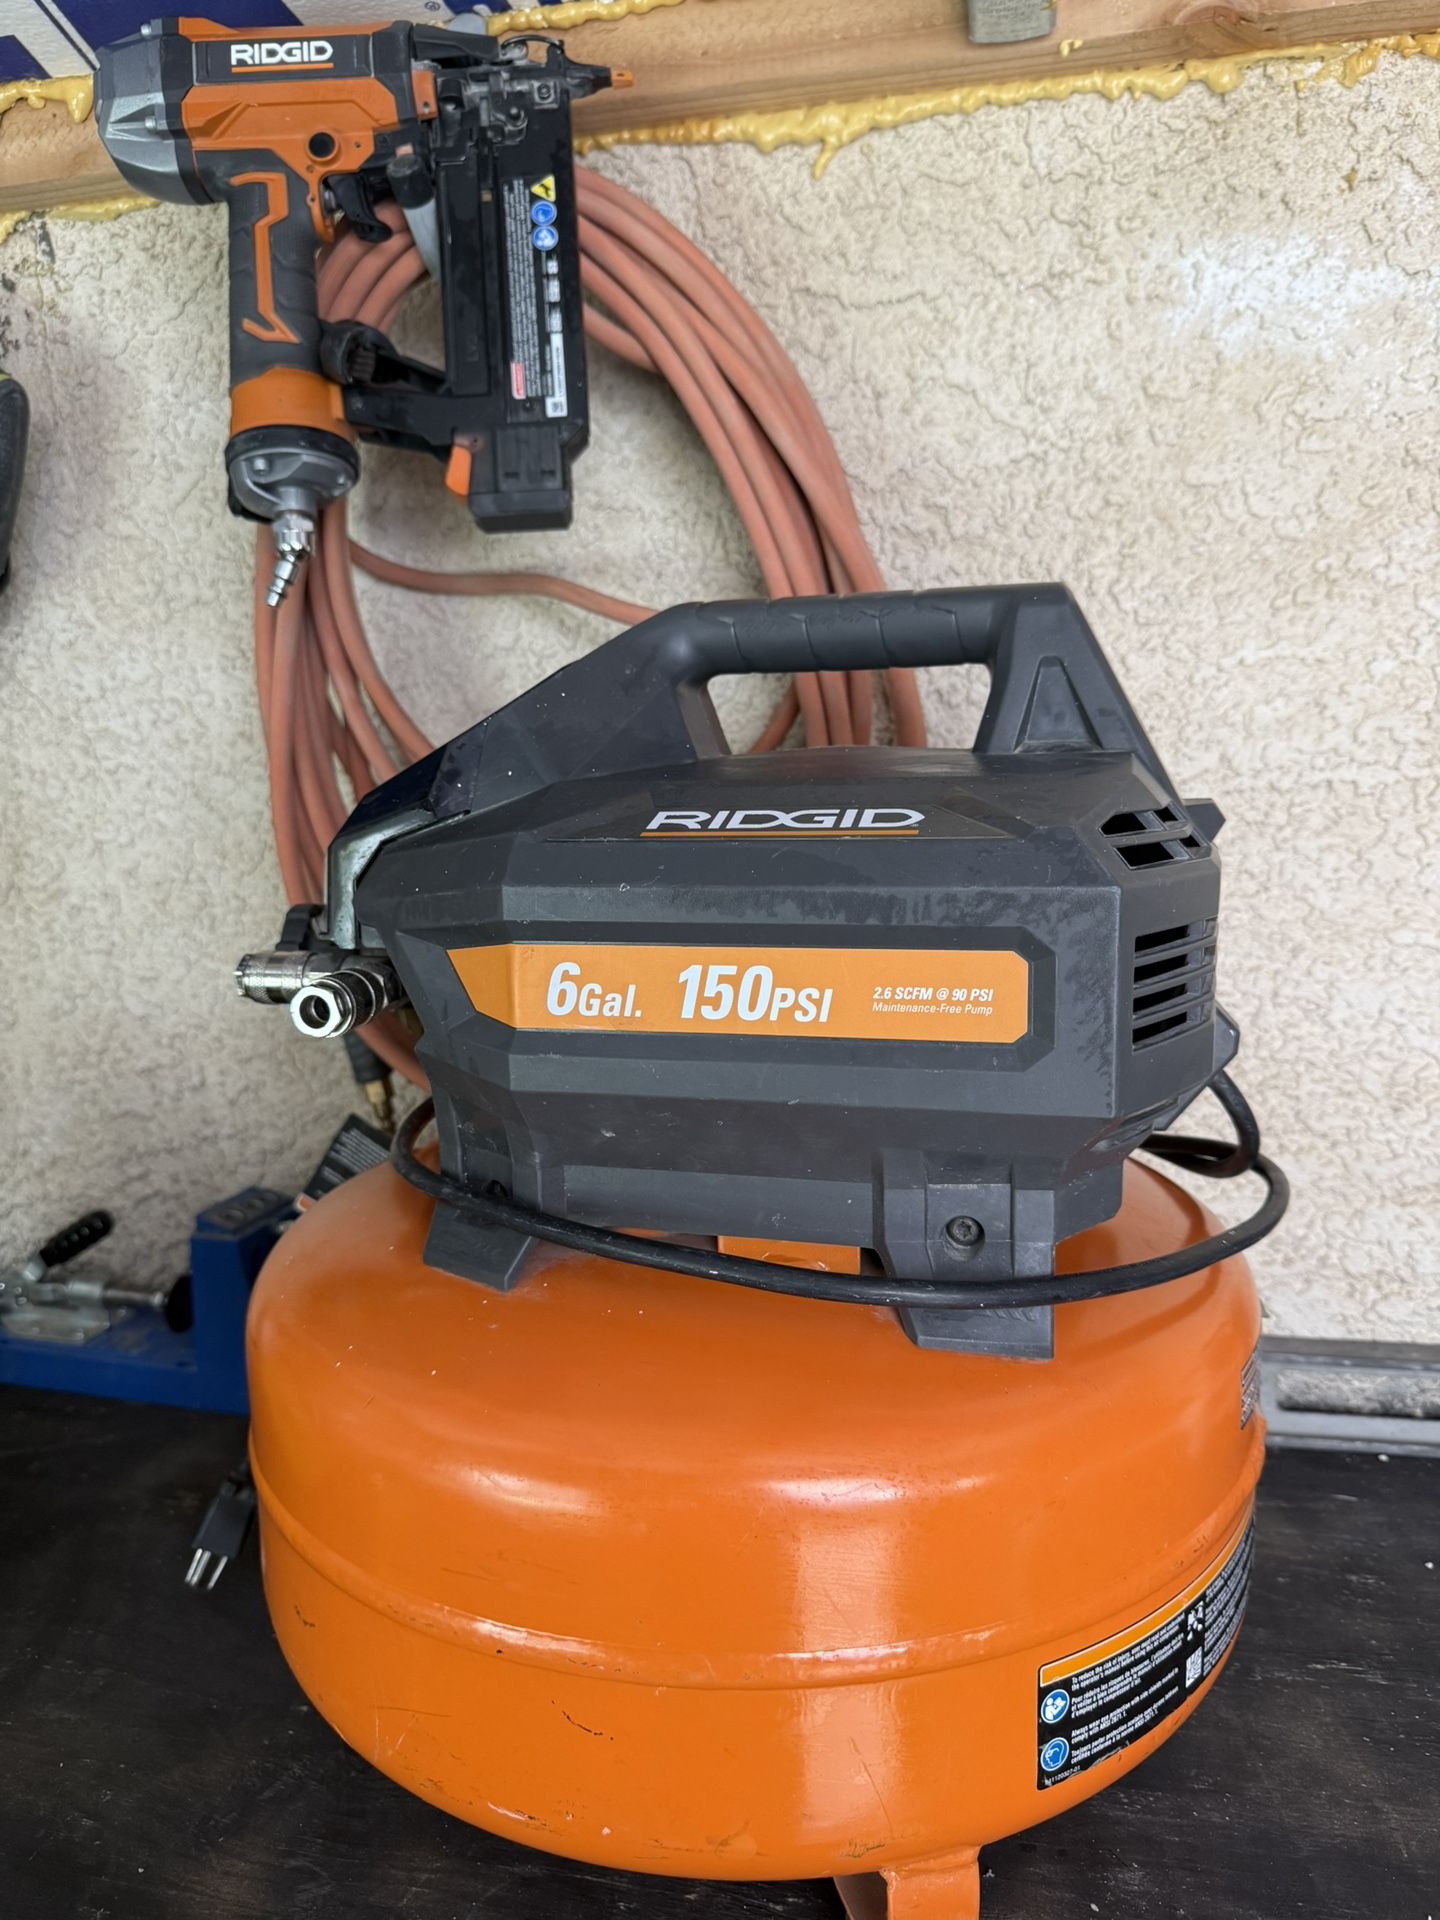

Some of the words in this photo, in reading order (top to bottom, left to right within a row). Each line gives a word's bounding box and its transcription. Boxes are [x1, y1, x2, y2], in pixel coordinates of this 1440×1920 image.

[230, 40, 334, 65] RIDGID
[645, 808, 926, 830] RIDGID
[873, 986, 892, 1000] 2.6
[894, 987, 933, 1001] SCFM
[936, 988, 949, 1001] @
[951, 988, 967, 1001] 90
[970, 988, 993, 1002] PSI
[872, 1002, 962, 1014] Maintenance-Free
[964, 1004, 993, 1016] Pump
[1078, 1670, 1094, 1681] reduce
[1072, 1696, 1083, 1704] Pour
[1072, 1726, 1088, 1737] Always
[1089, 1719, 1100, 1729] wear
[1072, 1732, 1088, 1744] comply
